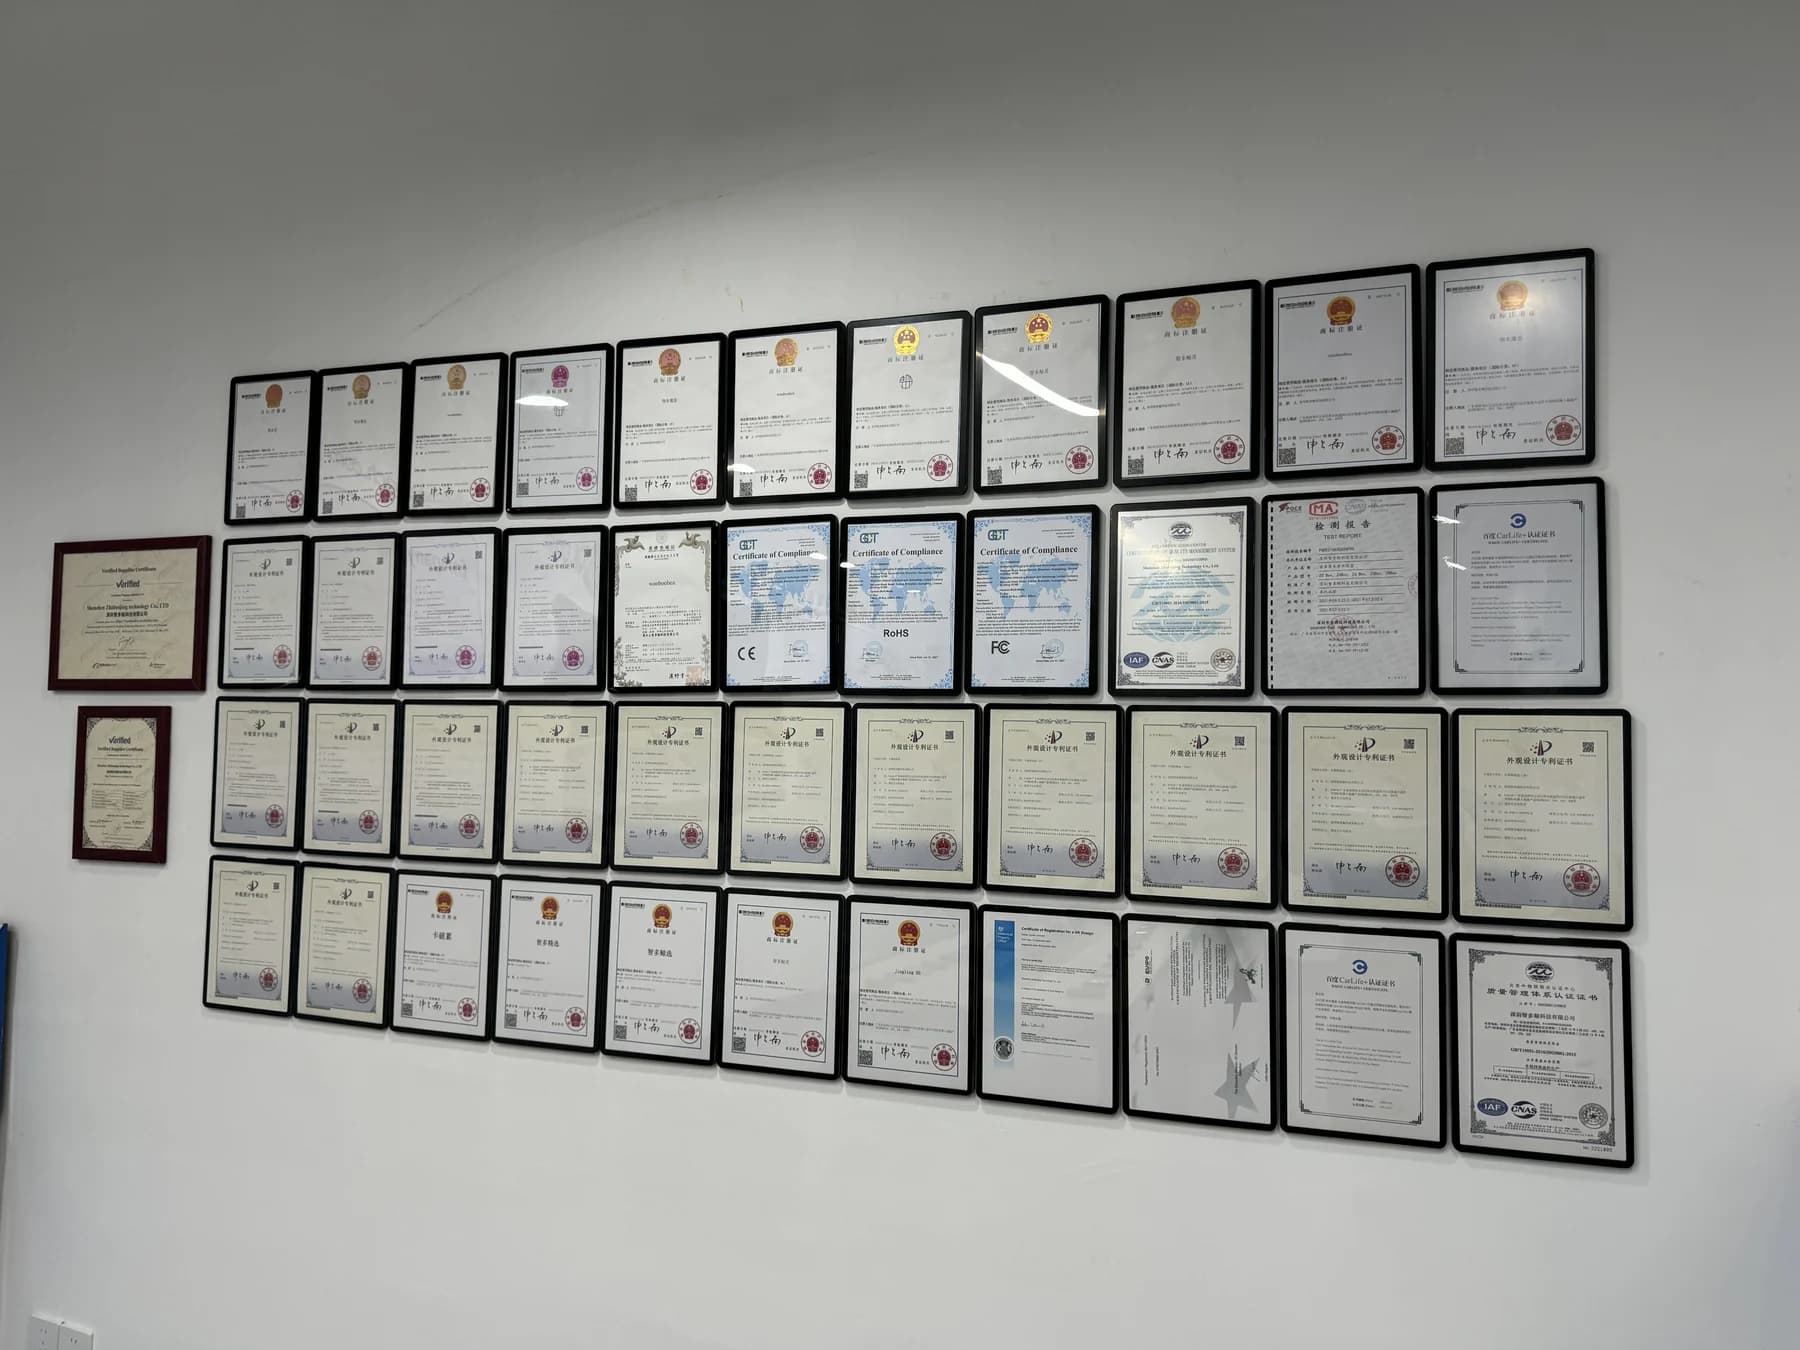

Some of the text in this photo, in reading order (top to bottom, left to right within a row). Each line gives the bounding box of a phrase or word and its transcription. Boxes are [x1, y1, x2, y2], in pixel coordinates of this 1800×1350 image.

[1315, 520, 1372, 530] 检测报告
[852, 547, 944, 558] Certificate of Compliance
[980, 545, 1078, 556] Certificate of Compliance
[732, 551, 768, 560] Certificate
[883, 629, 909, 638] RoHS
[737, 646, 756, 661] CE
[1151, 656, 1175, 664] CNAS
[1026, 744, 1079, 753] 外观设计专利证书
[1170, 750, 1227, 759] 外观设计专利证书
[1332, 752, 1396, 762] 外观设计专利证书
[1506, 756, 1573, 766] 外观设计专利证书
[1486, 987, 1599, 1001] 质量管理体系认证证书
[1484, 1103, 1502, 1111] IAF
[1511, 1106, 1537, 1115] CNAS
